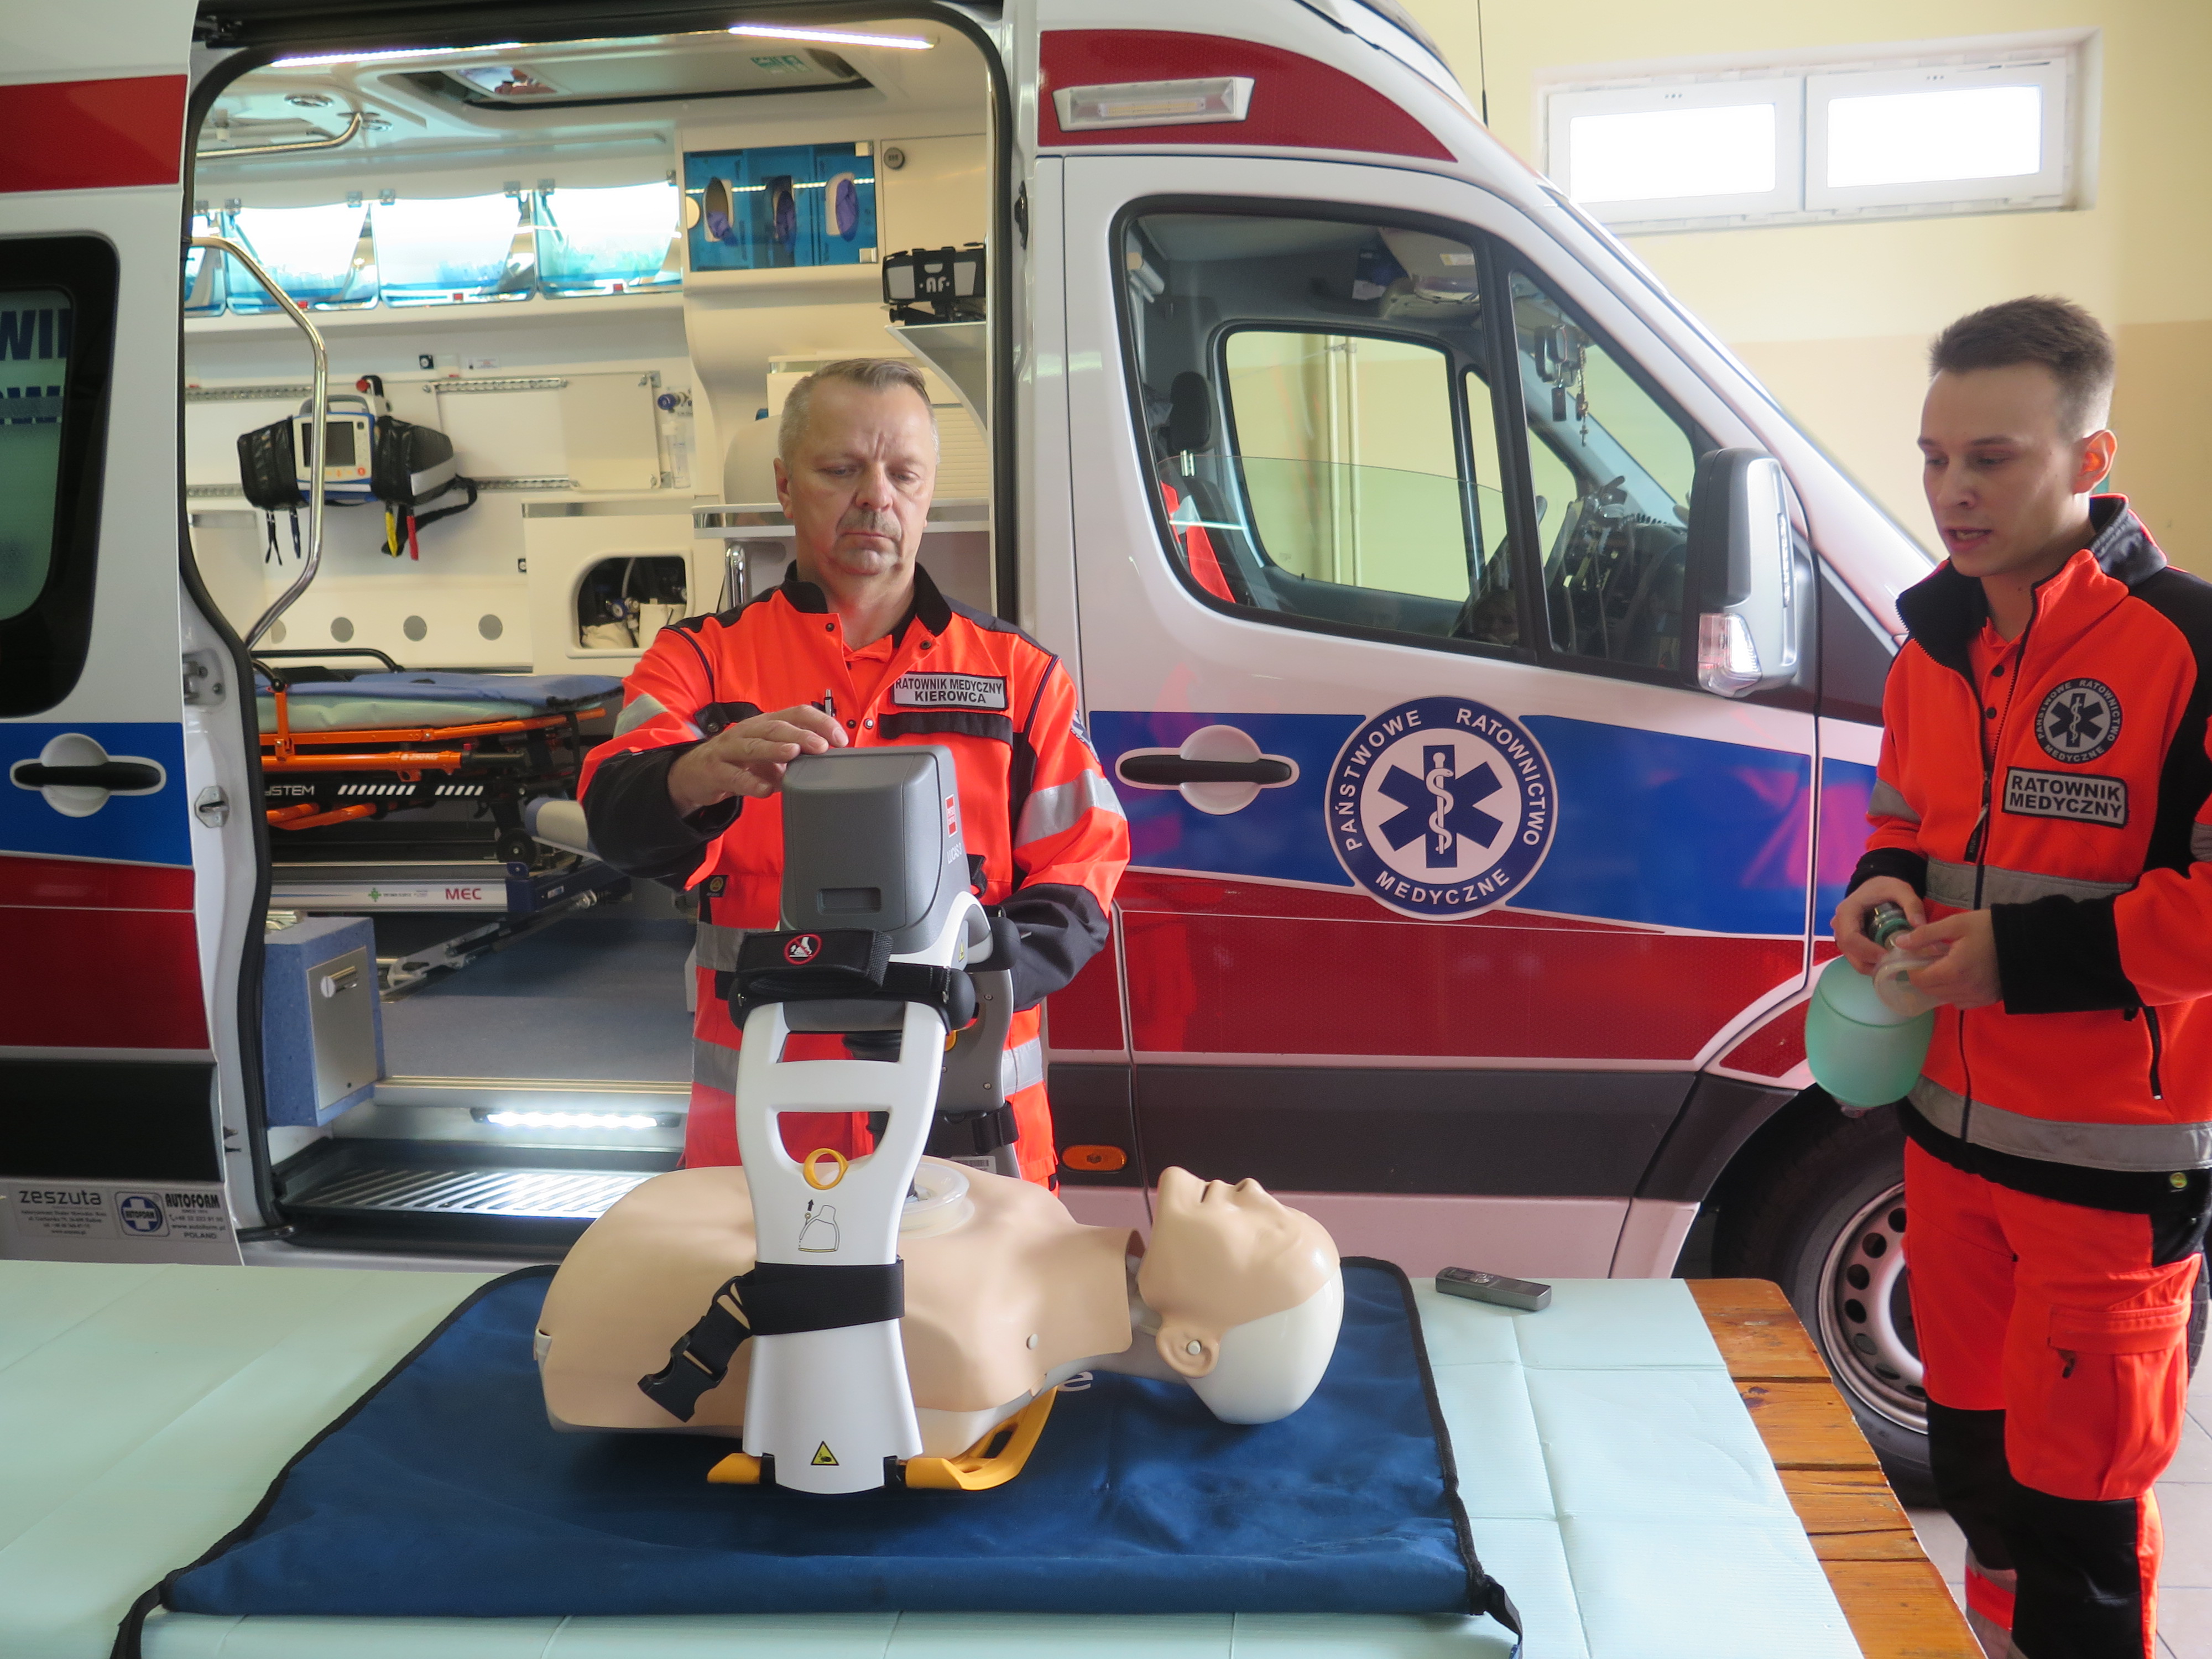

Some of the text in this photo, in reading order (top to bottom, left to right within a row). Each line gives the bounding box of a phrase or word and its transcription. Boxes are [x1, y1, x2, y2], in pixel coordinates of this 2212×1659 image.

[895, 678, 1002, 694] RATOWNIK MEDYCZNY
[915, 691, 986, 703] KIEROWCA
[2079, 680, 2121, 742] RATOWNICTWO
[2046, 744, 2104, 761] MEDYCZNE
[1334, 708, 1546, 851] PAŃSTWOWE RATOWNICTWO
[2011, 775, 2120, 802] RATOWNIK
[2009, 792, 2122, 818] MEDYCZNY
[445, 888, 482, 900] MEC
[1375, 868, 1510, 905] MEDYCZNE
[19, 1190, 102, 1205] zeszuta
[165, 1193, 220, 1209] AUTOFORM
